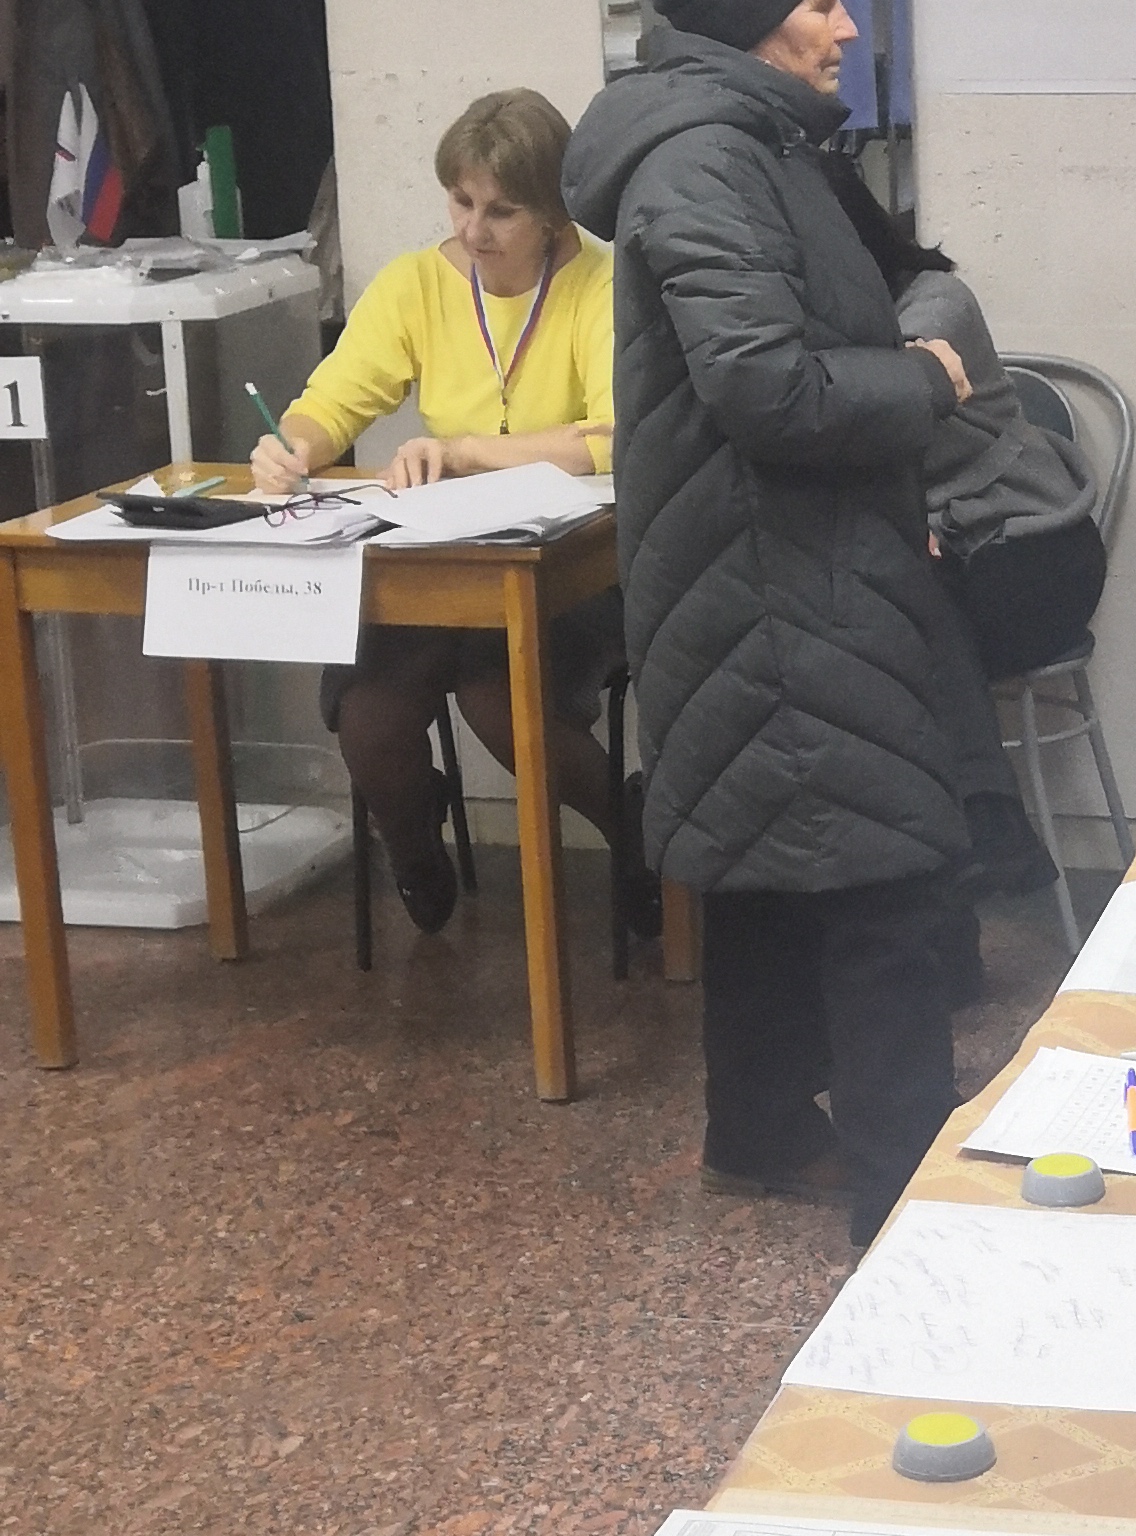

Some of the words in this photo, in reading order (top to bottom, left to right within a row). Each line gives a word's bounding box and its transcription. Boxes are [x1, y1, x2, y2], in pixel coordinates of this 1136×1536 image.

[188, 578, 224, 595] Пр-т
[232, 579, 299, 595] Победы,
[303, 580, 322, 595] 38
